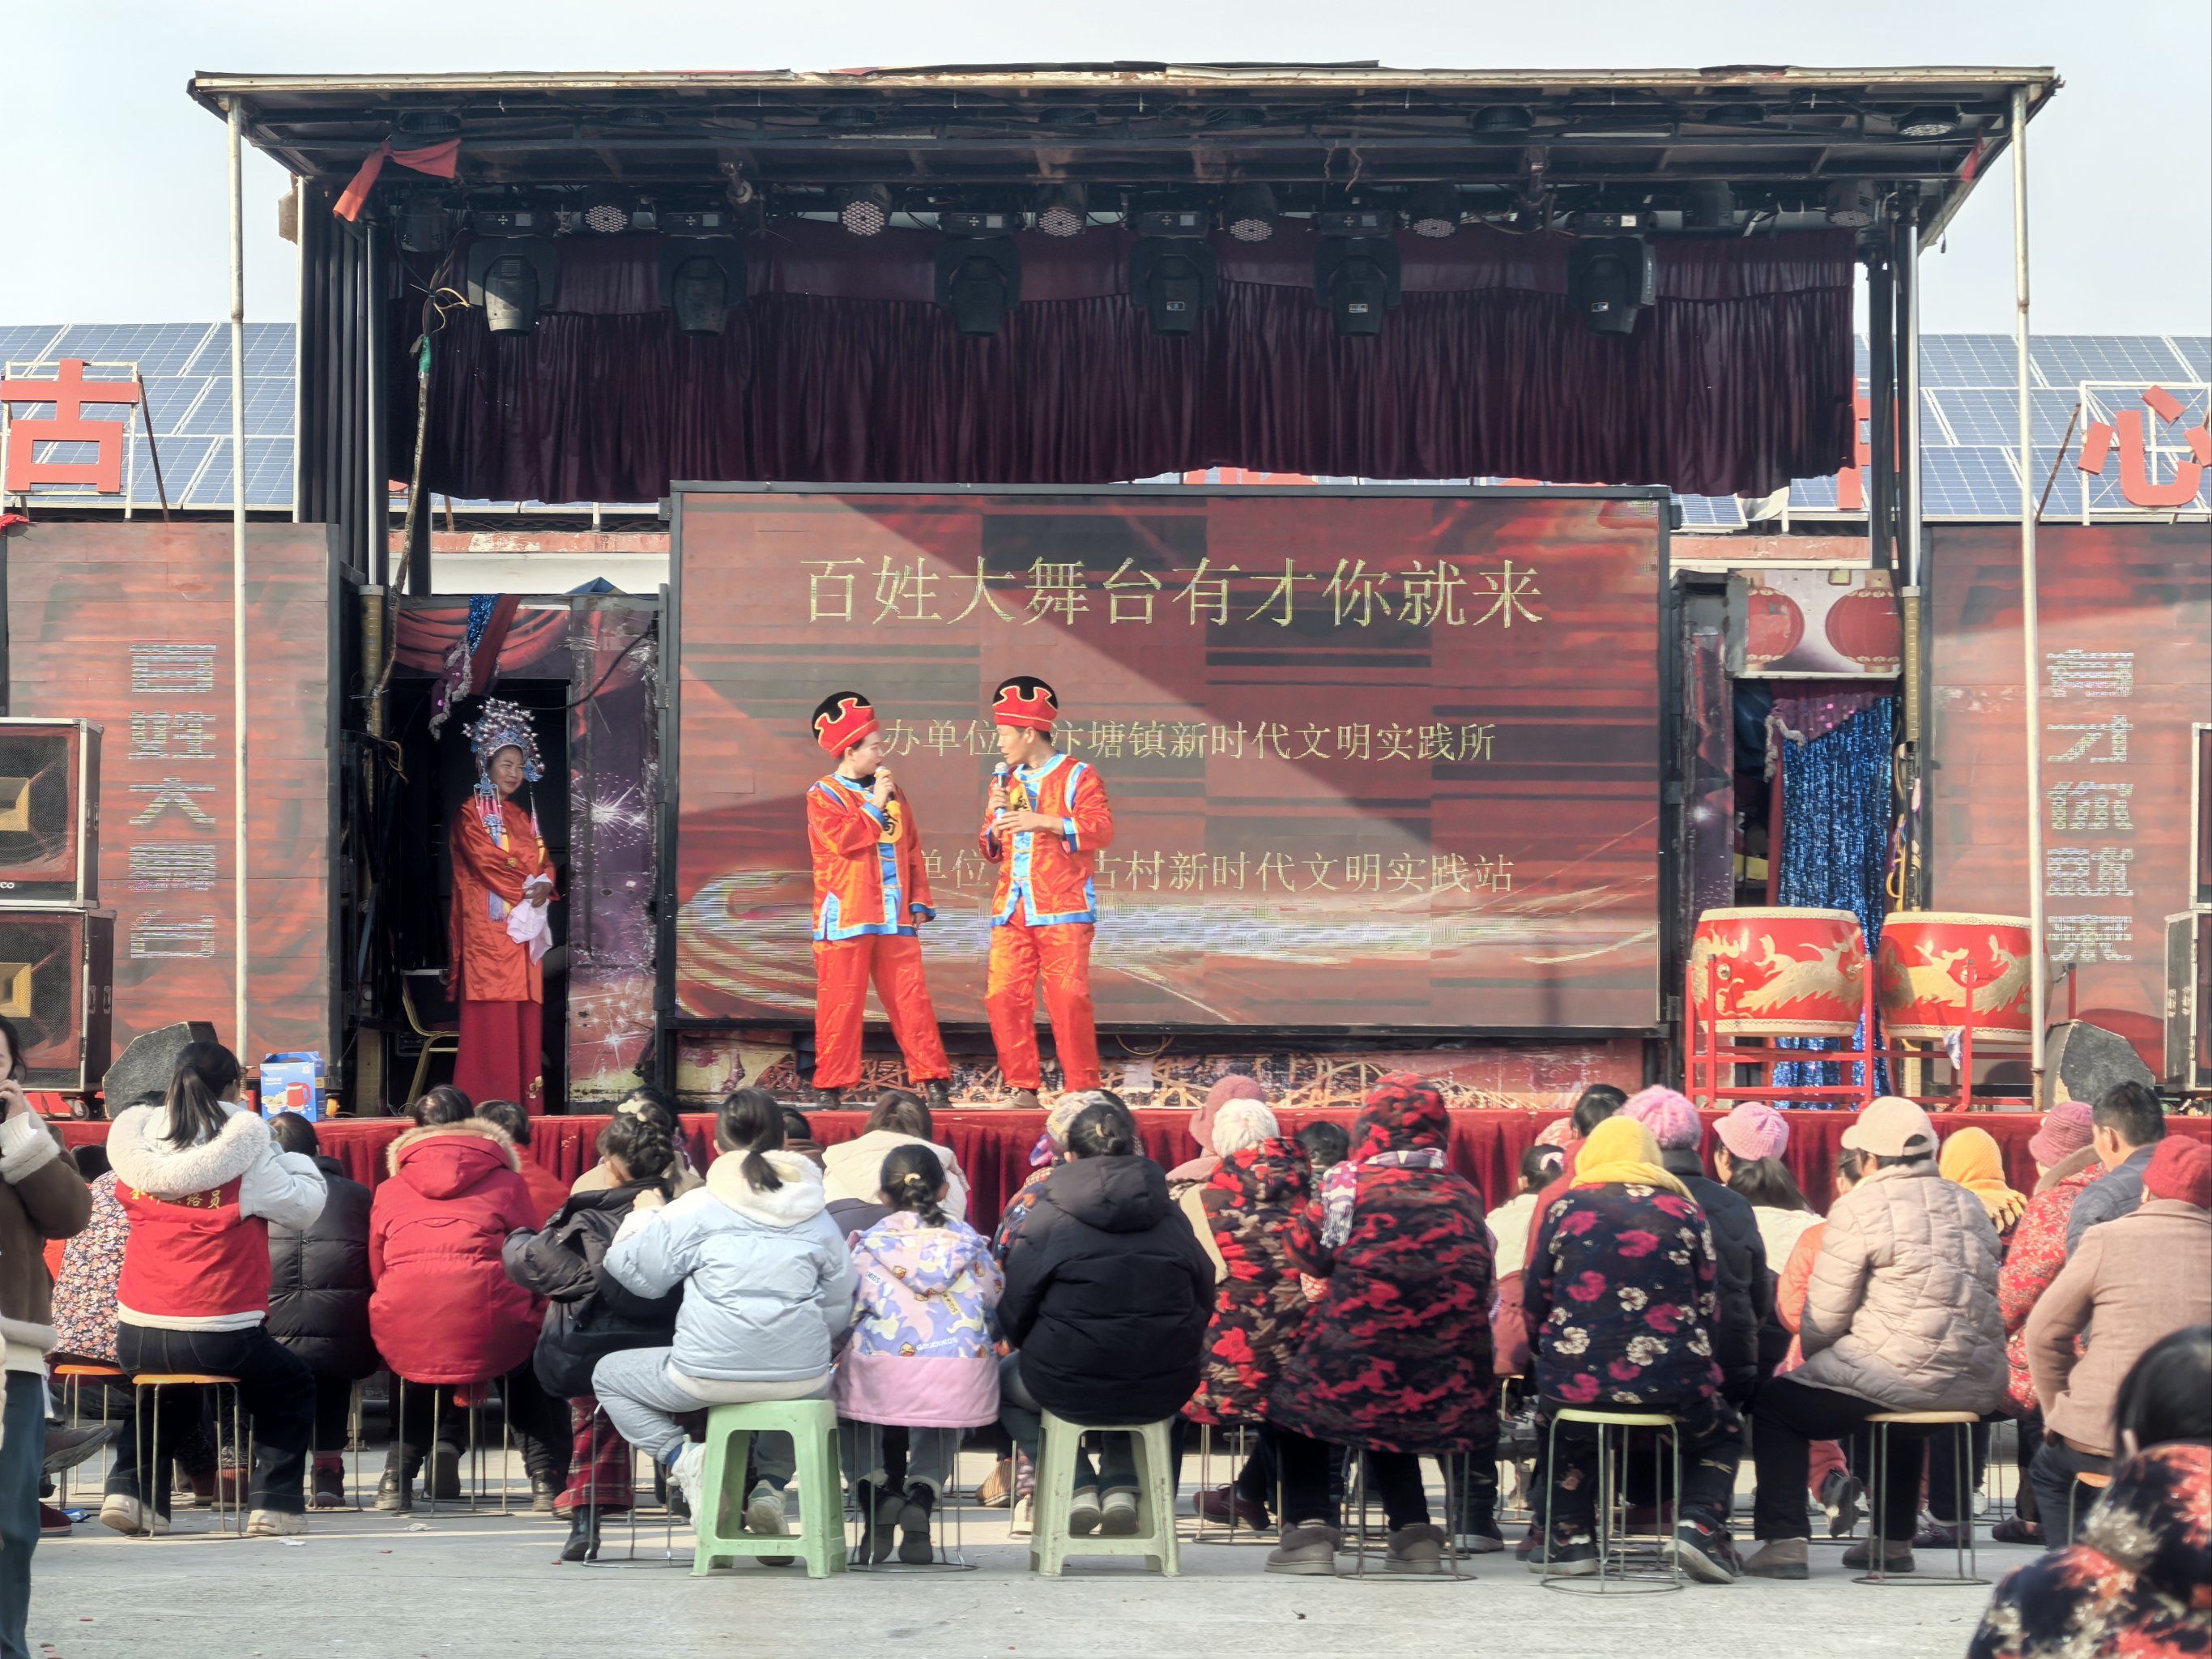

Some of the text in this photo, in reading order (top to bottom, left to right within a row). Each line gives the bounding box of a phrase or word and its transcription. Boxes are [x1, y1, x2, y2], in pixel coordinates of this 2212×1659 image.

[0, 358, 2212, 507] 古 心
[800, 555, 1543, 629] 百姓大舞台有才你就来
